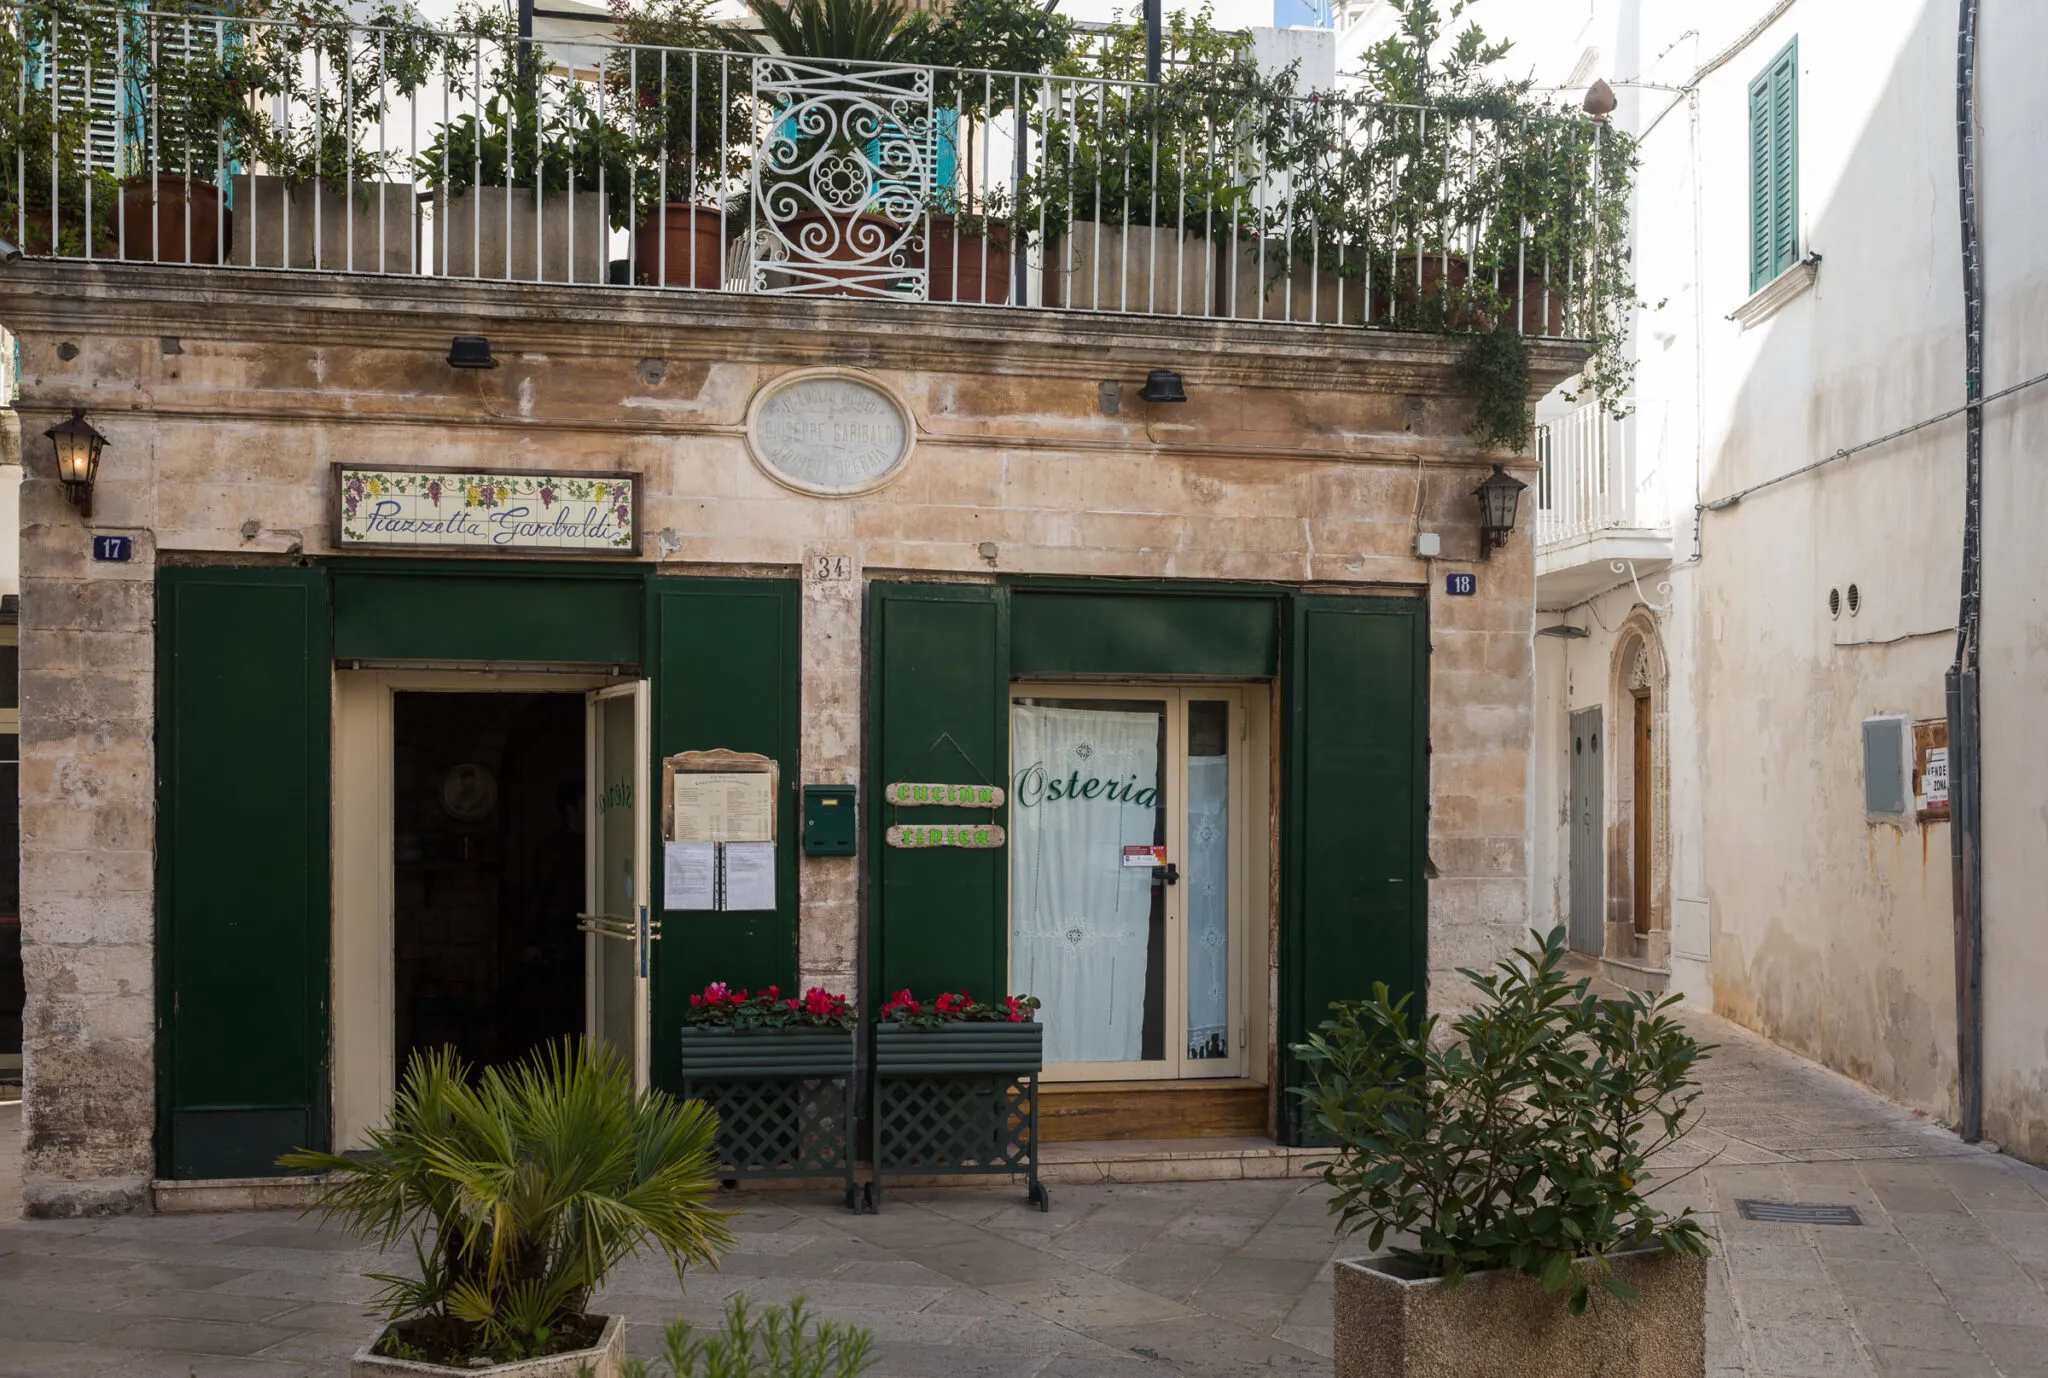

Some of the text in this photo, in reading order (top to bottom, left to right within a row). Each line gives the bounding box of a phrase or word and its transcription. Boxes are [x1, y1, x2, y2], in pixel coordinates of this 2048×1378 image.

[366, 500, 621, 545] Piazzetta Garibaldi
[103, 538, 121, 558] 17
[819, 557, 846, 579] 34
[1454, 576, 1470, 593] 18
[897, 784, 994, 802] cucina
[1013, 762, 1159, 810] Osteria
[902, 827, 990, 847] tipica
